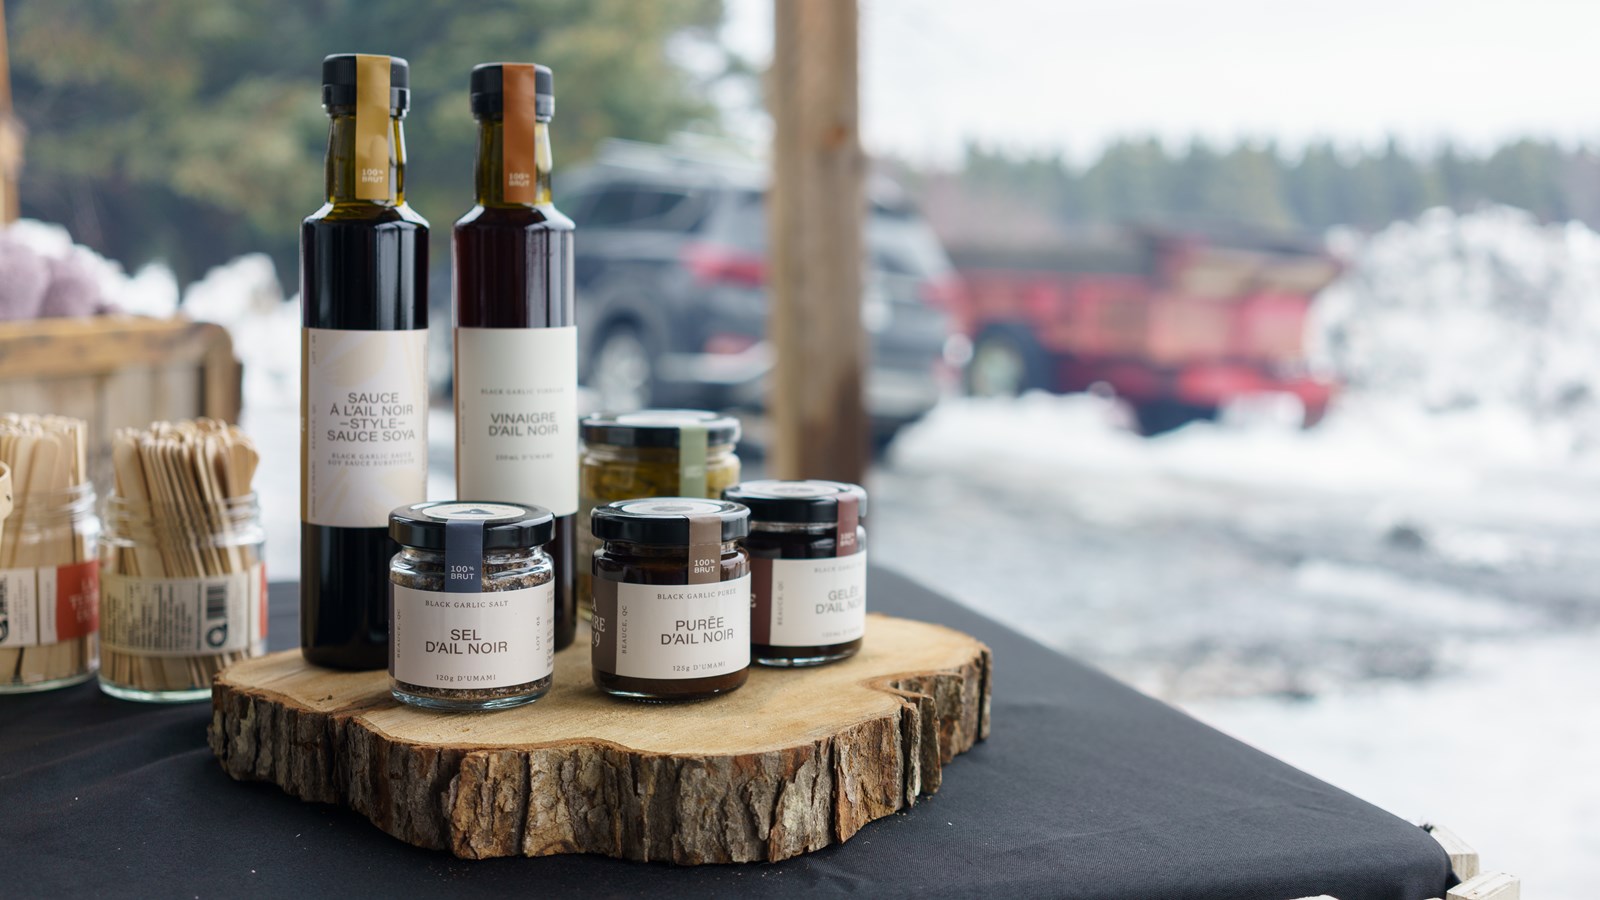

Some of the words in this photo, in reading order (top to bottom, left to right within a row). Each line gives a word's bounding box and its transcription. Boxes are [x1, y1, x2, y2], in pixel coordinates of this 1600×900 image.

[362, 168, 384, 176] 100%
[362, 176, 384, 184] BRUT
[348, 392, 399, 404] SAUCE
[344, 404, 377, 416] L'AIL
[382, 404, 414, 416] NOIR
[491, 412, 557, 424] VINAIGRE
[327, 430, 378, 442] SAUCE
[382, 430, 416, 442] SOYA
[488, 424, 522, 437] D'AIL
[528, 424, 559, 436] NOIR
[331, 452, 356, 460] BLACK
[450, 565, 474, 573] 100%
[694, 566, 715, 574] BRUT
[657, 592, 684, 600] BLACK
[687, 592, 716, 600] GARLIC
[425, 600, 452, 608] BLACK
[454, 600, 486, 608] GARLIC
[488, 600, 508, 608] SALT
[816, 601, 844, 614] D'AIL
[622, 605, 628, 616] QC
[676, 616, 724, 632] PURÉE
[450, 628, 482, 641] SEL
[661, 632, 699, 646] D'AIL
[703, 630, 734, 644] NOIR
[426, 641, 463, 654] D'AIL
[468, 640, 508, 654] NOIR
[672, 664, 690, 672] 125g
[693, 662, 726, 671] D'UMAMI
[436, 674, 454, 682] 120g
[457, 674, 496, 682] D'UMAMI
